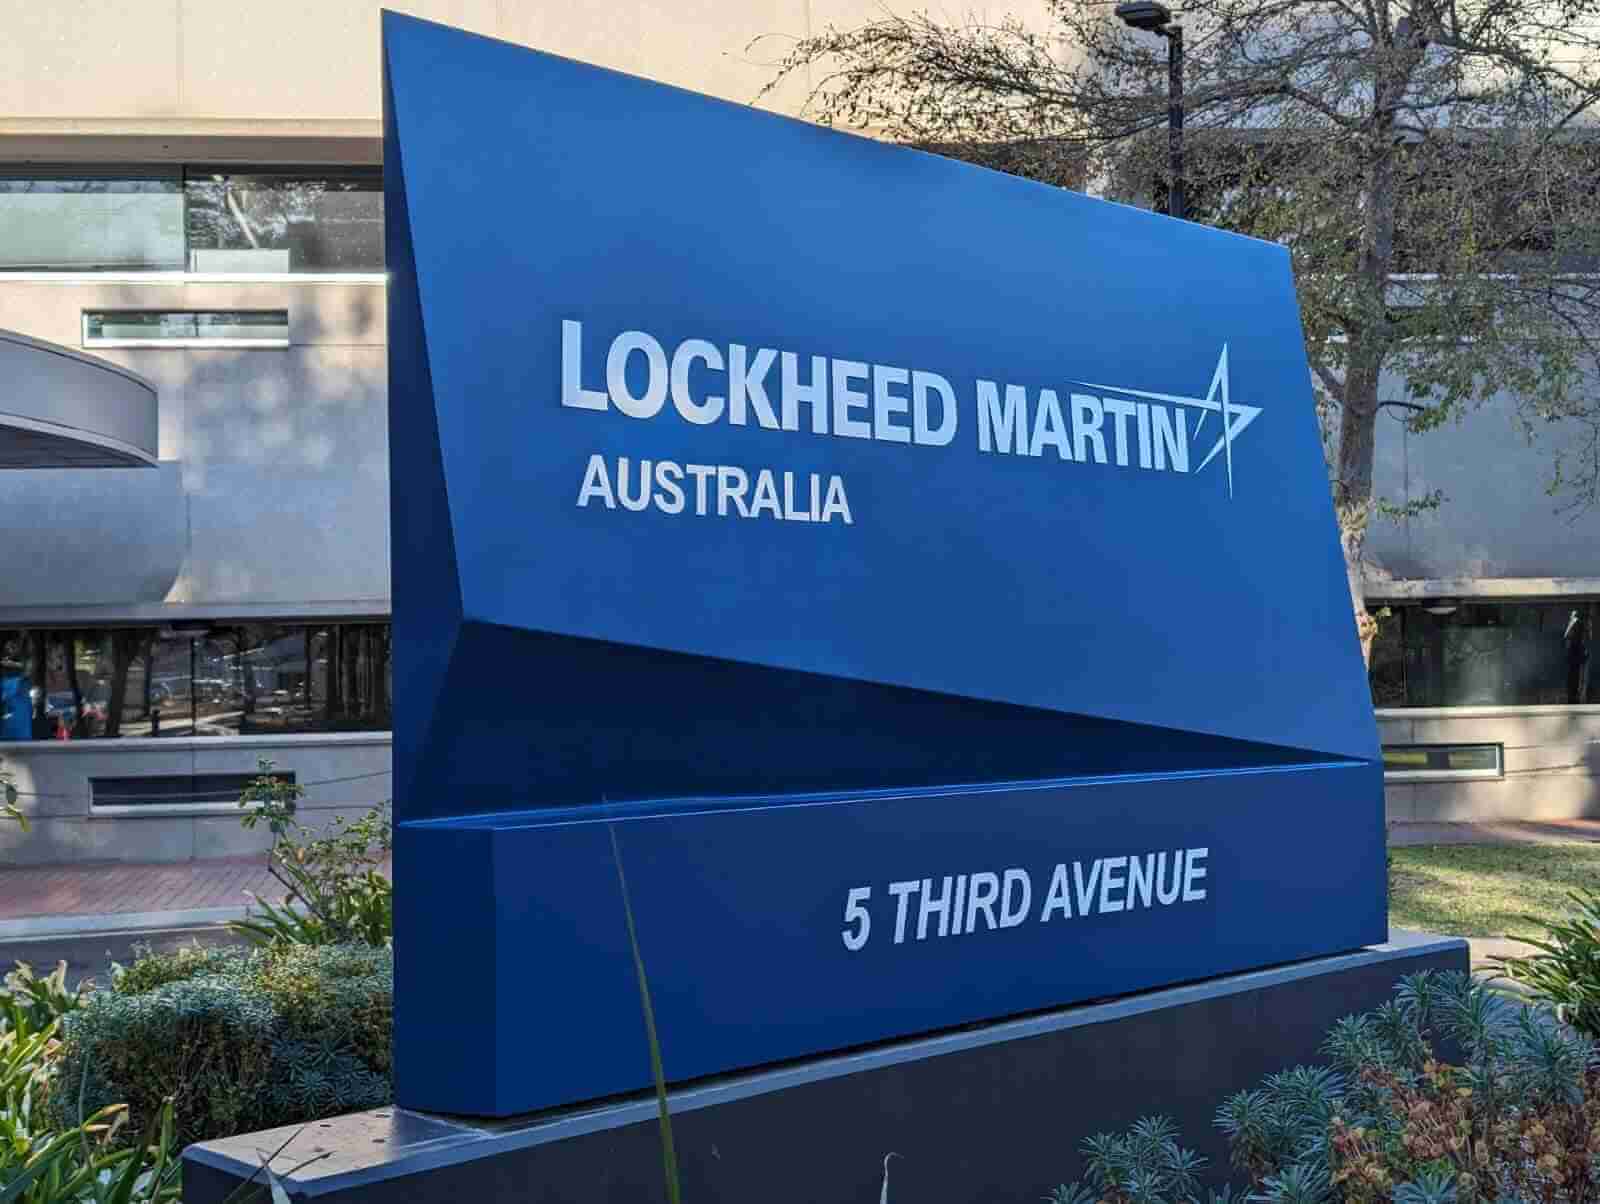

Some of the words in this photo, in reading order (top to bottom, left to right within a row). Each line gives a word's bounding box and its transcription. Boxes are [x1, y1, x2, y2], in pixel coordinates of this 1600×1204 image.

[561, 319, 958, 447] LOCKHEED
[976, 380, 1189, 474] MARTIN
[577, 454, 853, 525] AUSTRALIA
[842, 886, 871, 951] 5
[889, 868, 1031, 945] THIRD
[1039, 847, 1209, 923] AVENUE
